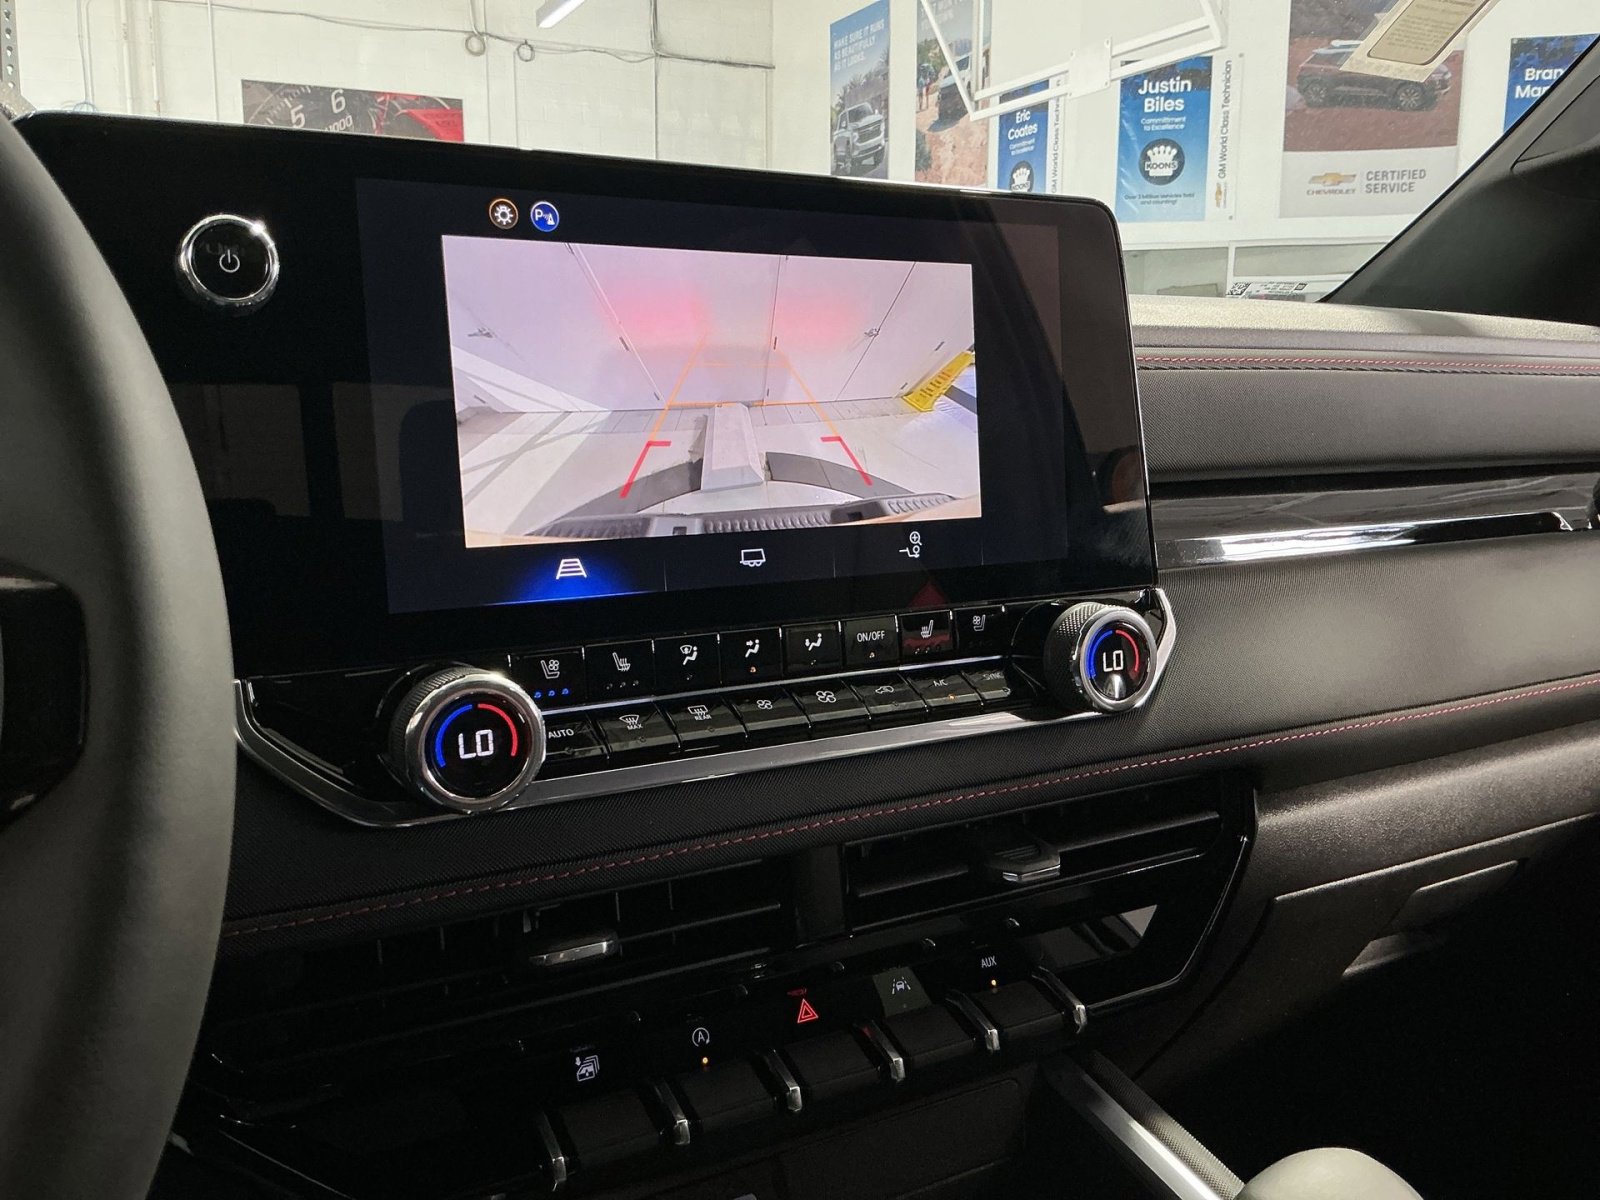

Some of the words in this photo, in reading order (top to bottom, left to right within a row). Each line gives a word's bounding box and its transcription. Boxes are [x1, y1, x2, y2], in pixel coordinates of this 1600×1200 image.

[1138, 76, 1192, 95] Justin
[1221, 60, 1232, 109] Technician
[331, 88, 346, 114] 6
[1144, 98, 1185, 113] Biles
[1015, 109, 1031, 124] Eric
[1220, 110, 1230, 134] Class
[1008, 122, 1038, 141] Coates
[1219, 136, 1229, 162] World
[1051, 153, 1059, 178] World
[1146, 162, 1177, 170] KOONS
[1217, 163, 1227, 179] GM
[1366, 168, 1427, 182] CERTIFIED
[1306, 188, 1356, 196] CHEVROLET
[1365, 181, 1415, 194] SERVICE
[534, 209, 543, 221] P
[856, 629, 885, 643] ON/OFF
[1102, 650, 1124, 672] LO
[548, 728, 575, 739] AUTO
[458, 728, 494, 760] LO
[981, 956, 998, 969] AUX
[698, 1031, 705, 1043] A
